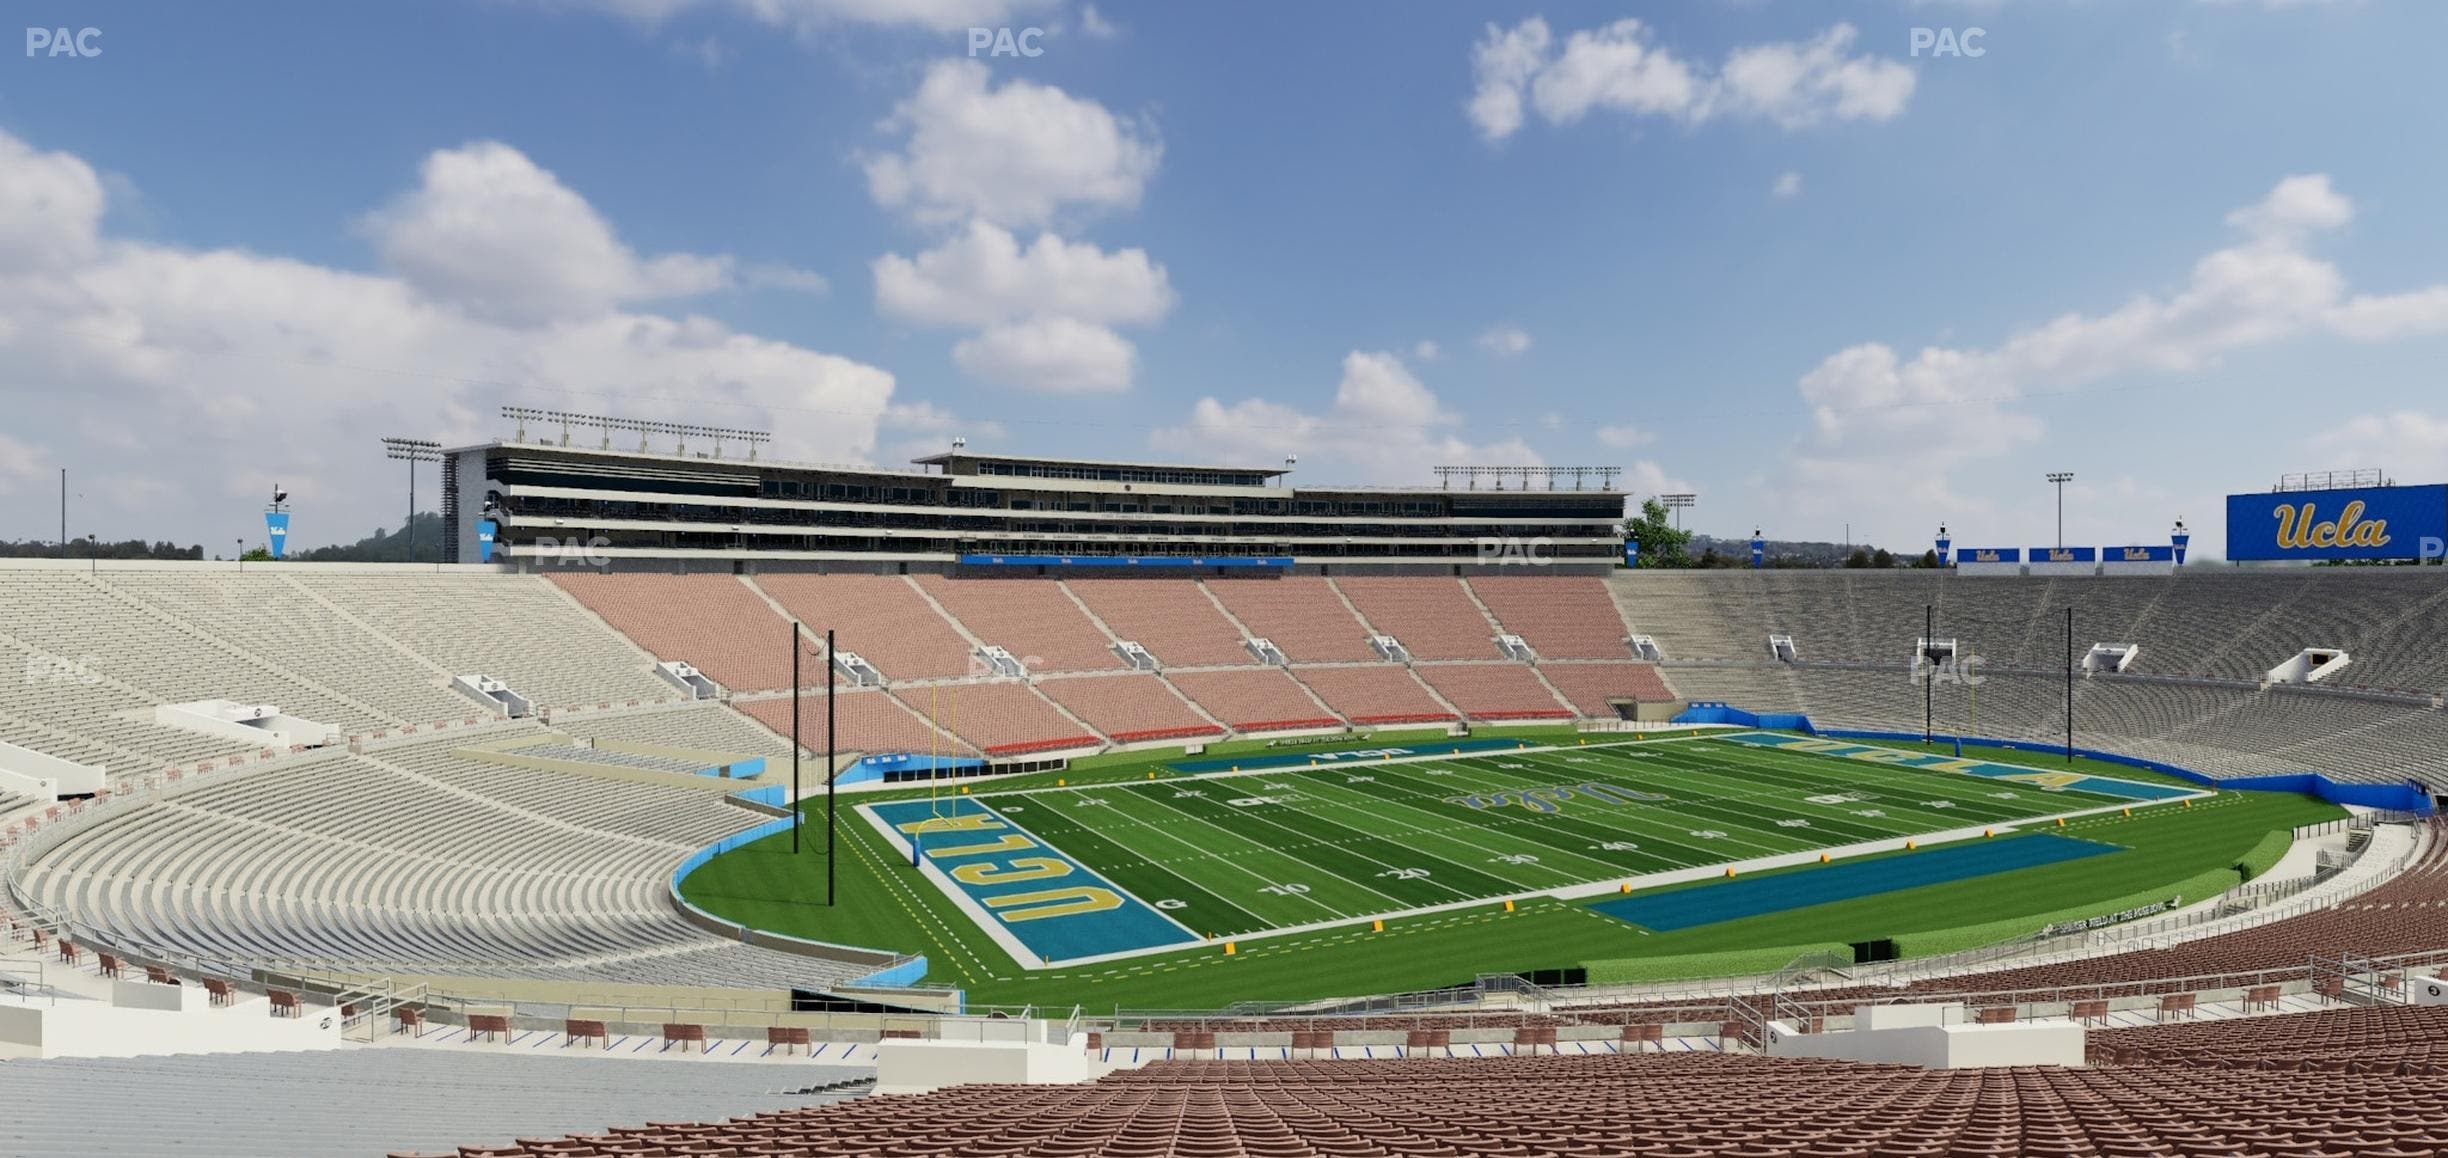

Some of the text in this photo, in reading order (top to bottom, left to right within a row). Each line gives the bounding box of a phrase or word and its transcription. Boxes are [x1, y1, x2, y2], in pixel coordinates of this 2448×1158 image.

[2273, 500, 2391, 549] Ucla
[1601, 841, 1639, 851] 40
[1499, 854, 1540, 865] 30
[1387, 867, 1431, 880] 20
[1267, 883, 1311, 896] 10
[1155, 898, 1188, 910] G
